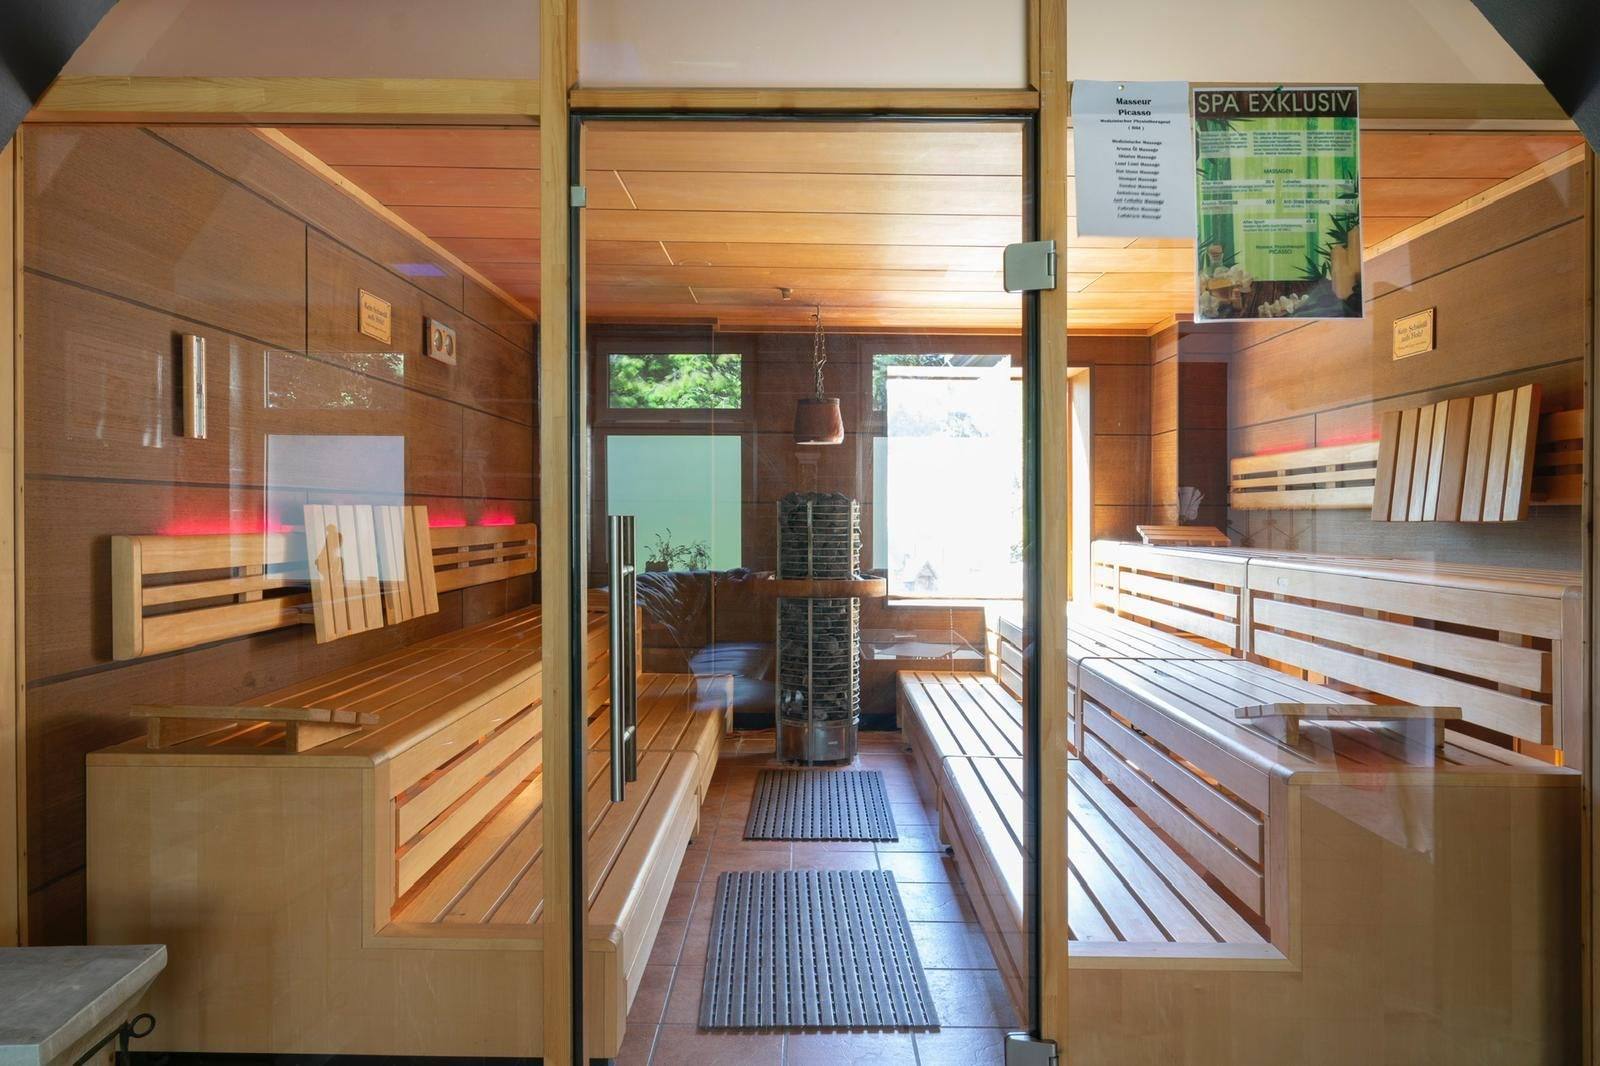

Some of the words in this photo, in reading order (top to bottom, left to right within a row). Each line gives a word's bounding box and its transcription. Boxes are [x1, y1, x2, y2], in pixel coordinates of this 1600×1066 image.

[1116, 97, 1152, 105] Masseur
[1198, 93, 1240, 113] SPA
[1249, 92, 1352, 112] EXKLUSIV
